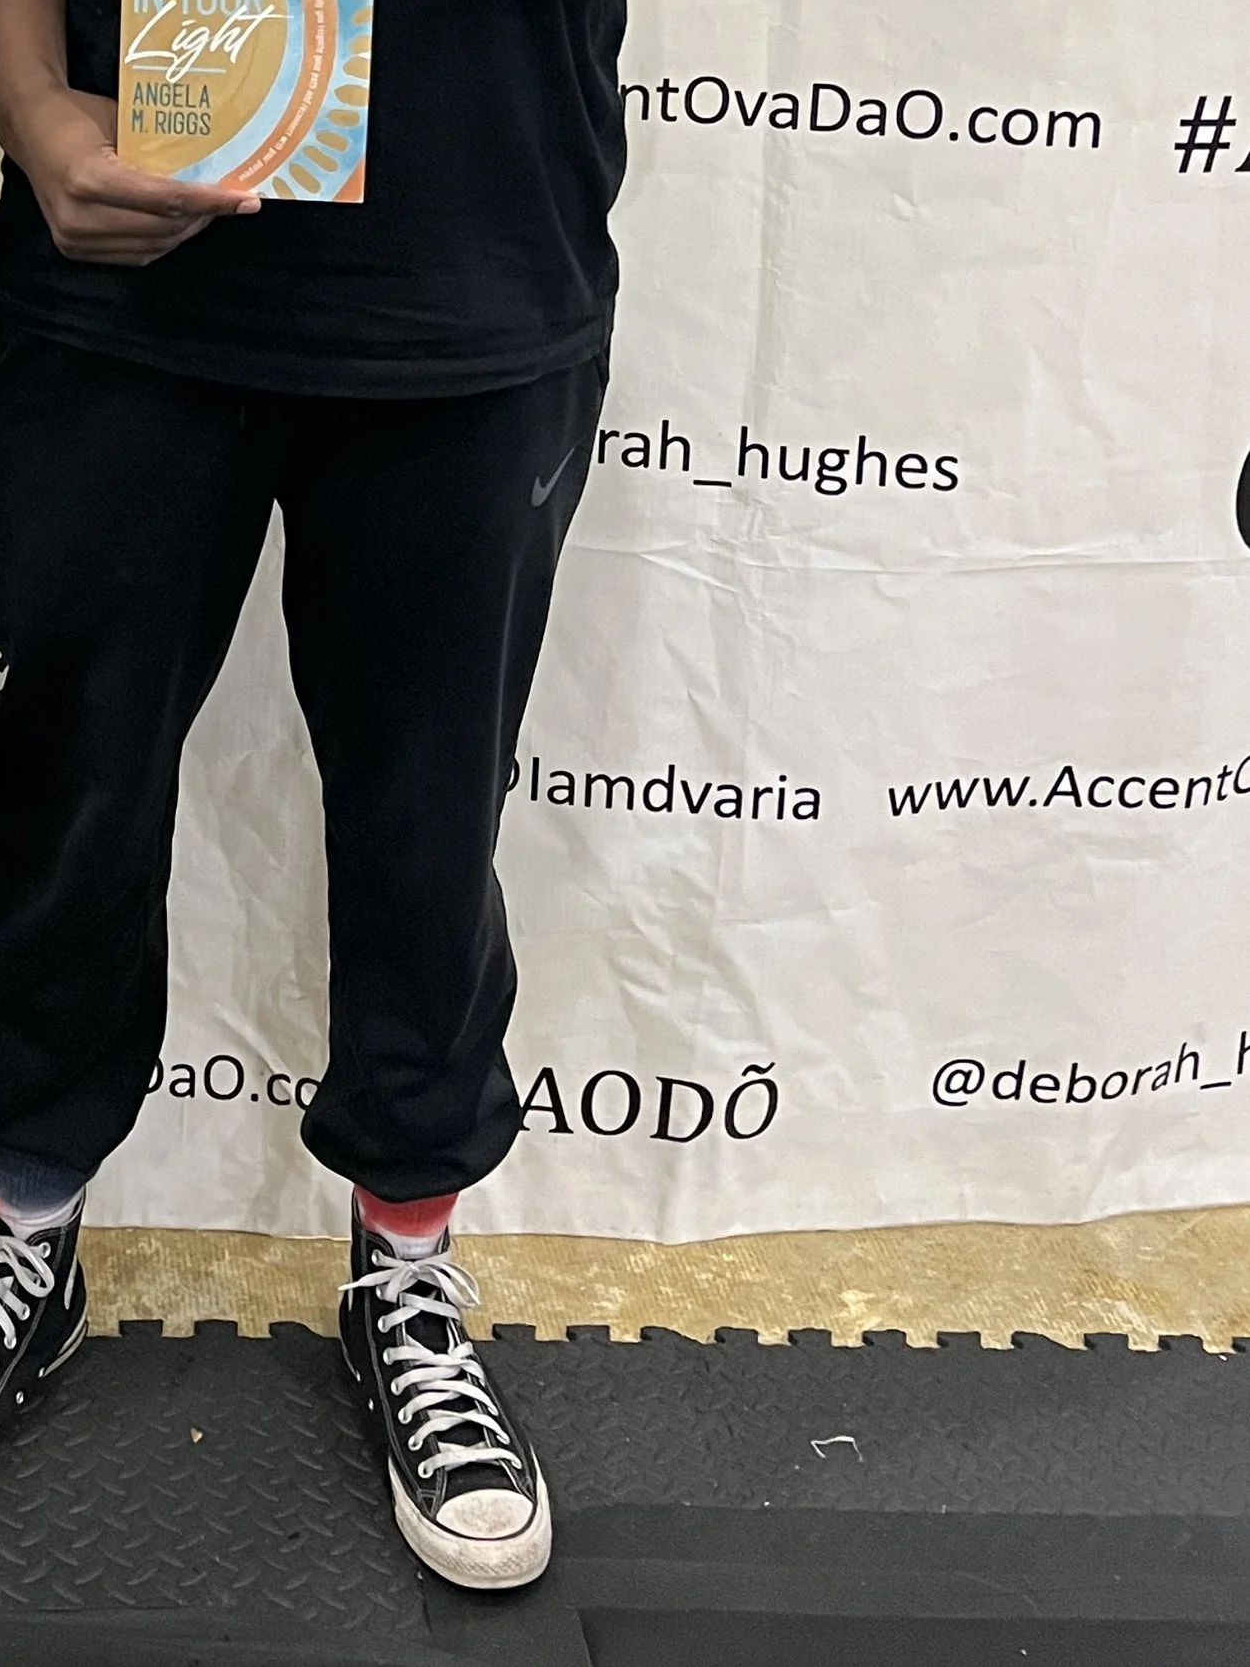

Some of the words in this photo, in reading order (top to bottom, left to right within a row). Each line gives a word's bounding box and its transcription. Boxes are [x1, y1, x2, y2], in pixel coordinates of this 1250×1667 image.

[124, 0, 295, 84] Light
[132, 81, 211, 109] ANGELA
[131, 111, 149, 135] M.
[154, 111, 211, 136] RIGGS
[505, 755, 822, 821] Iamdvaria
